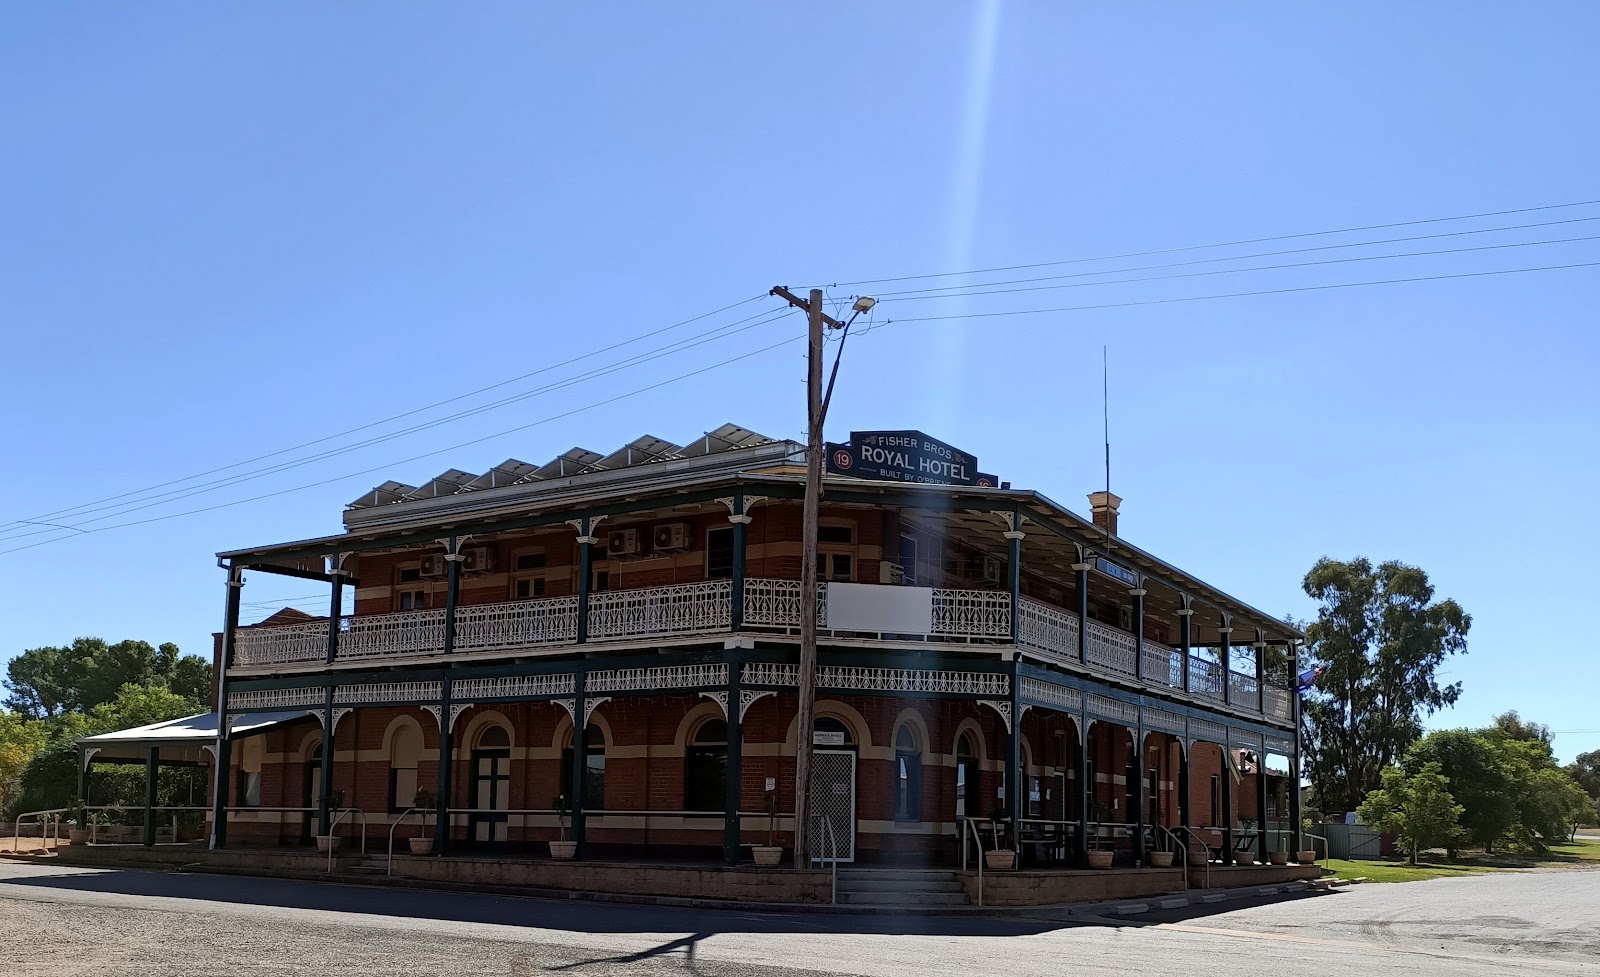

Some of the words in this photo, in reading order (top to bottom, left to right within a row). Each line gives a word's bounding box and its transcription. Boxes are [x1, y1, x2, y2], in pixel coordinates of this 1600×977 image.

[878, 436, 918, 449] FISHER
[923, 441, 954, 461] BROS.
[837, 453, 849, 466] 19
[861, 445, 915, 470] ROYAL
[919, 457, 971, 481] HOTEL
[880, 469, 901, 479] BUILT
[904, 473, 914, 481] BY
